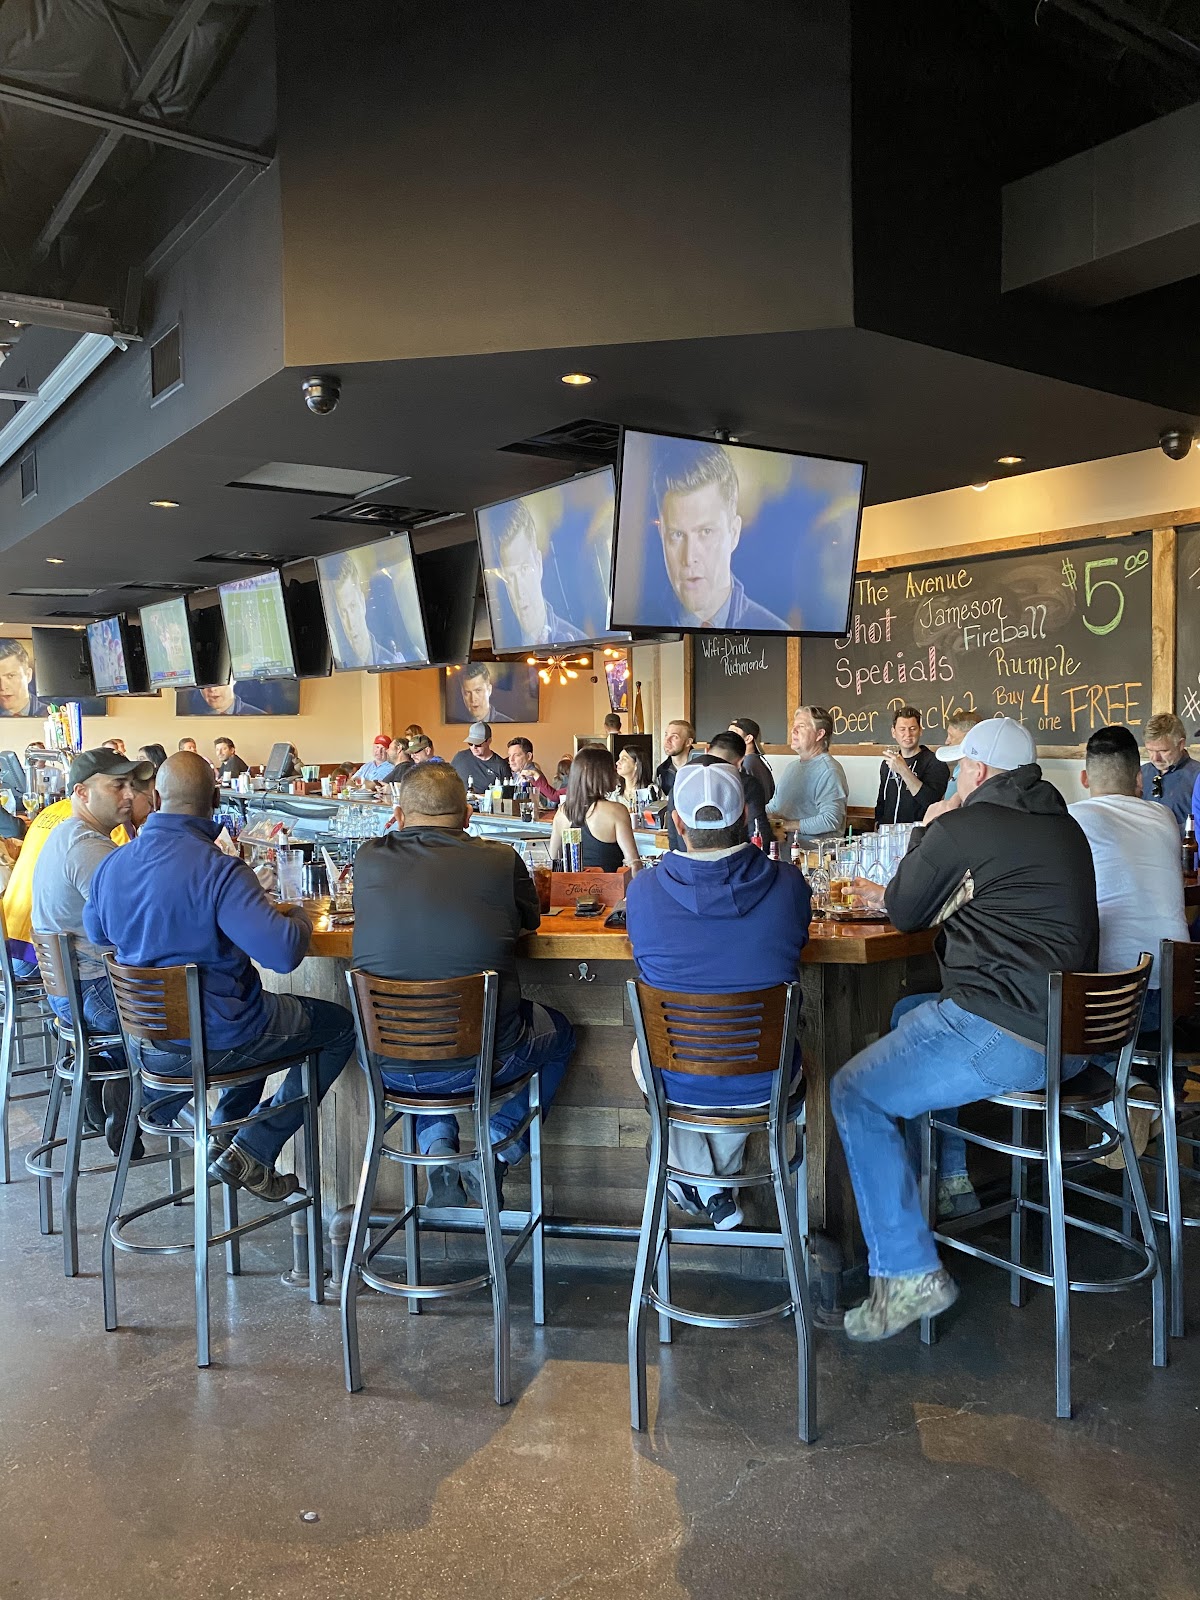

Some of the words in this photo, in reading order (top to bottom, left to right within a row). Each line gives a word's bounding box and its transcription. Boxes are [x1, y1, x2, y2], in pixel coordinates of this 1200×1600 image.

[855, 579, 889, 606] The
[906, 569, 973, 599] Avenue
[919, 596, 1008, 629] Jameson
[963, 604, 1047, 650] Fireball
[720, 648, 769, 677] Richmond
[835, 645, 954, 696] Specials
[989, 644, 1081, 681] Rumple
[992, 685, 1025, 711] Buy
[1031, 683, 1050, 716] 4
[1038, 715, 1062, 731] one
[1061, 682, 1143, 733] FREE
[828, 705, 879, 736] Beer
